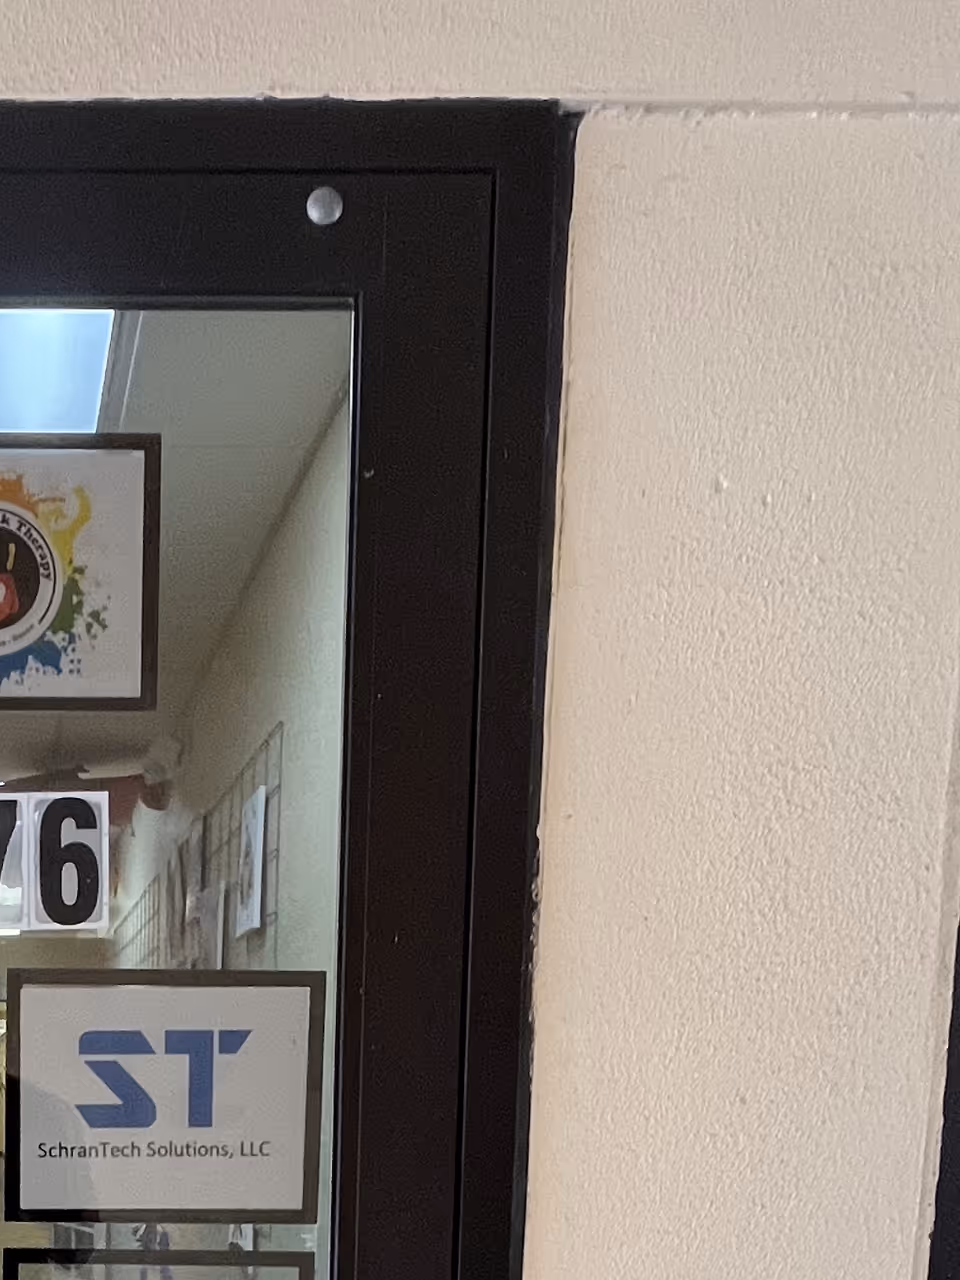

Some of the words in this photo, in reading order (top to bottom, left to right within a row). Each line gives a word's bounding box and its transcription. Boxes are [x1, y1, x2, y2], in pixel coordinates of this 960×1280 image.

[16, 519, 52, 582] Therapy
[74, 1030, 253, 1129] ST
[38, 1142, 141, 1158] SchranTech
[146, 1140, 234, 1159] Solutions,
[240, 1141, 271, 1157] LLC
